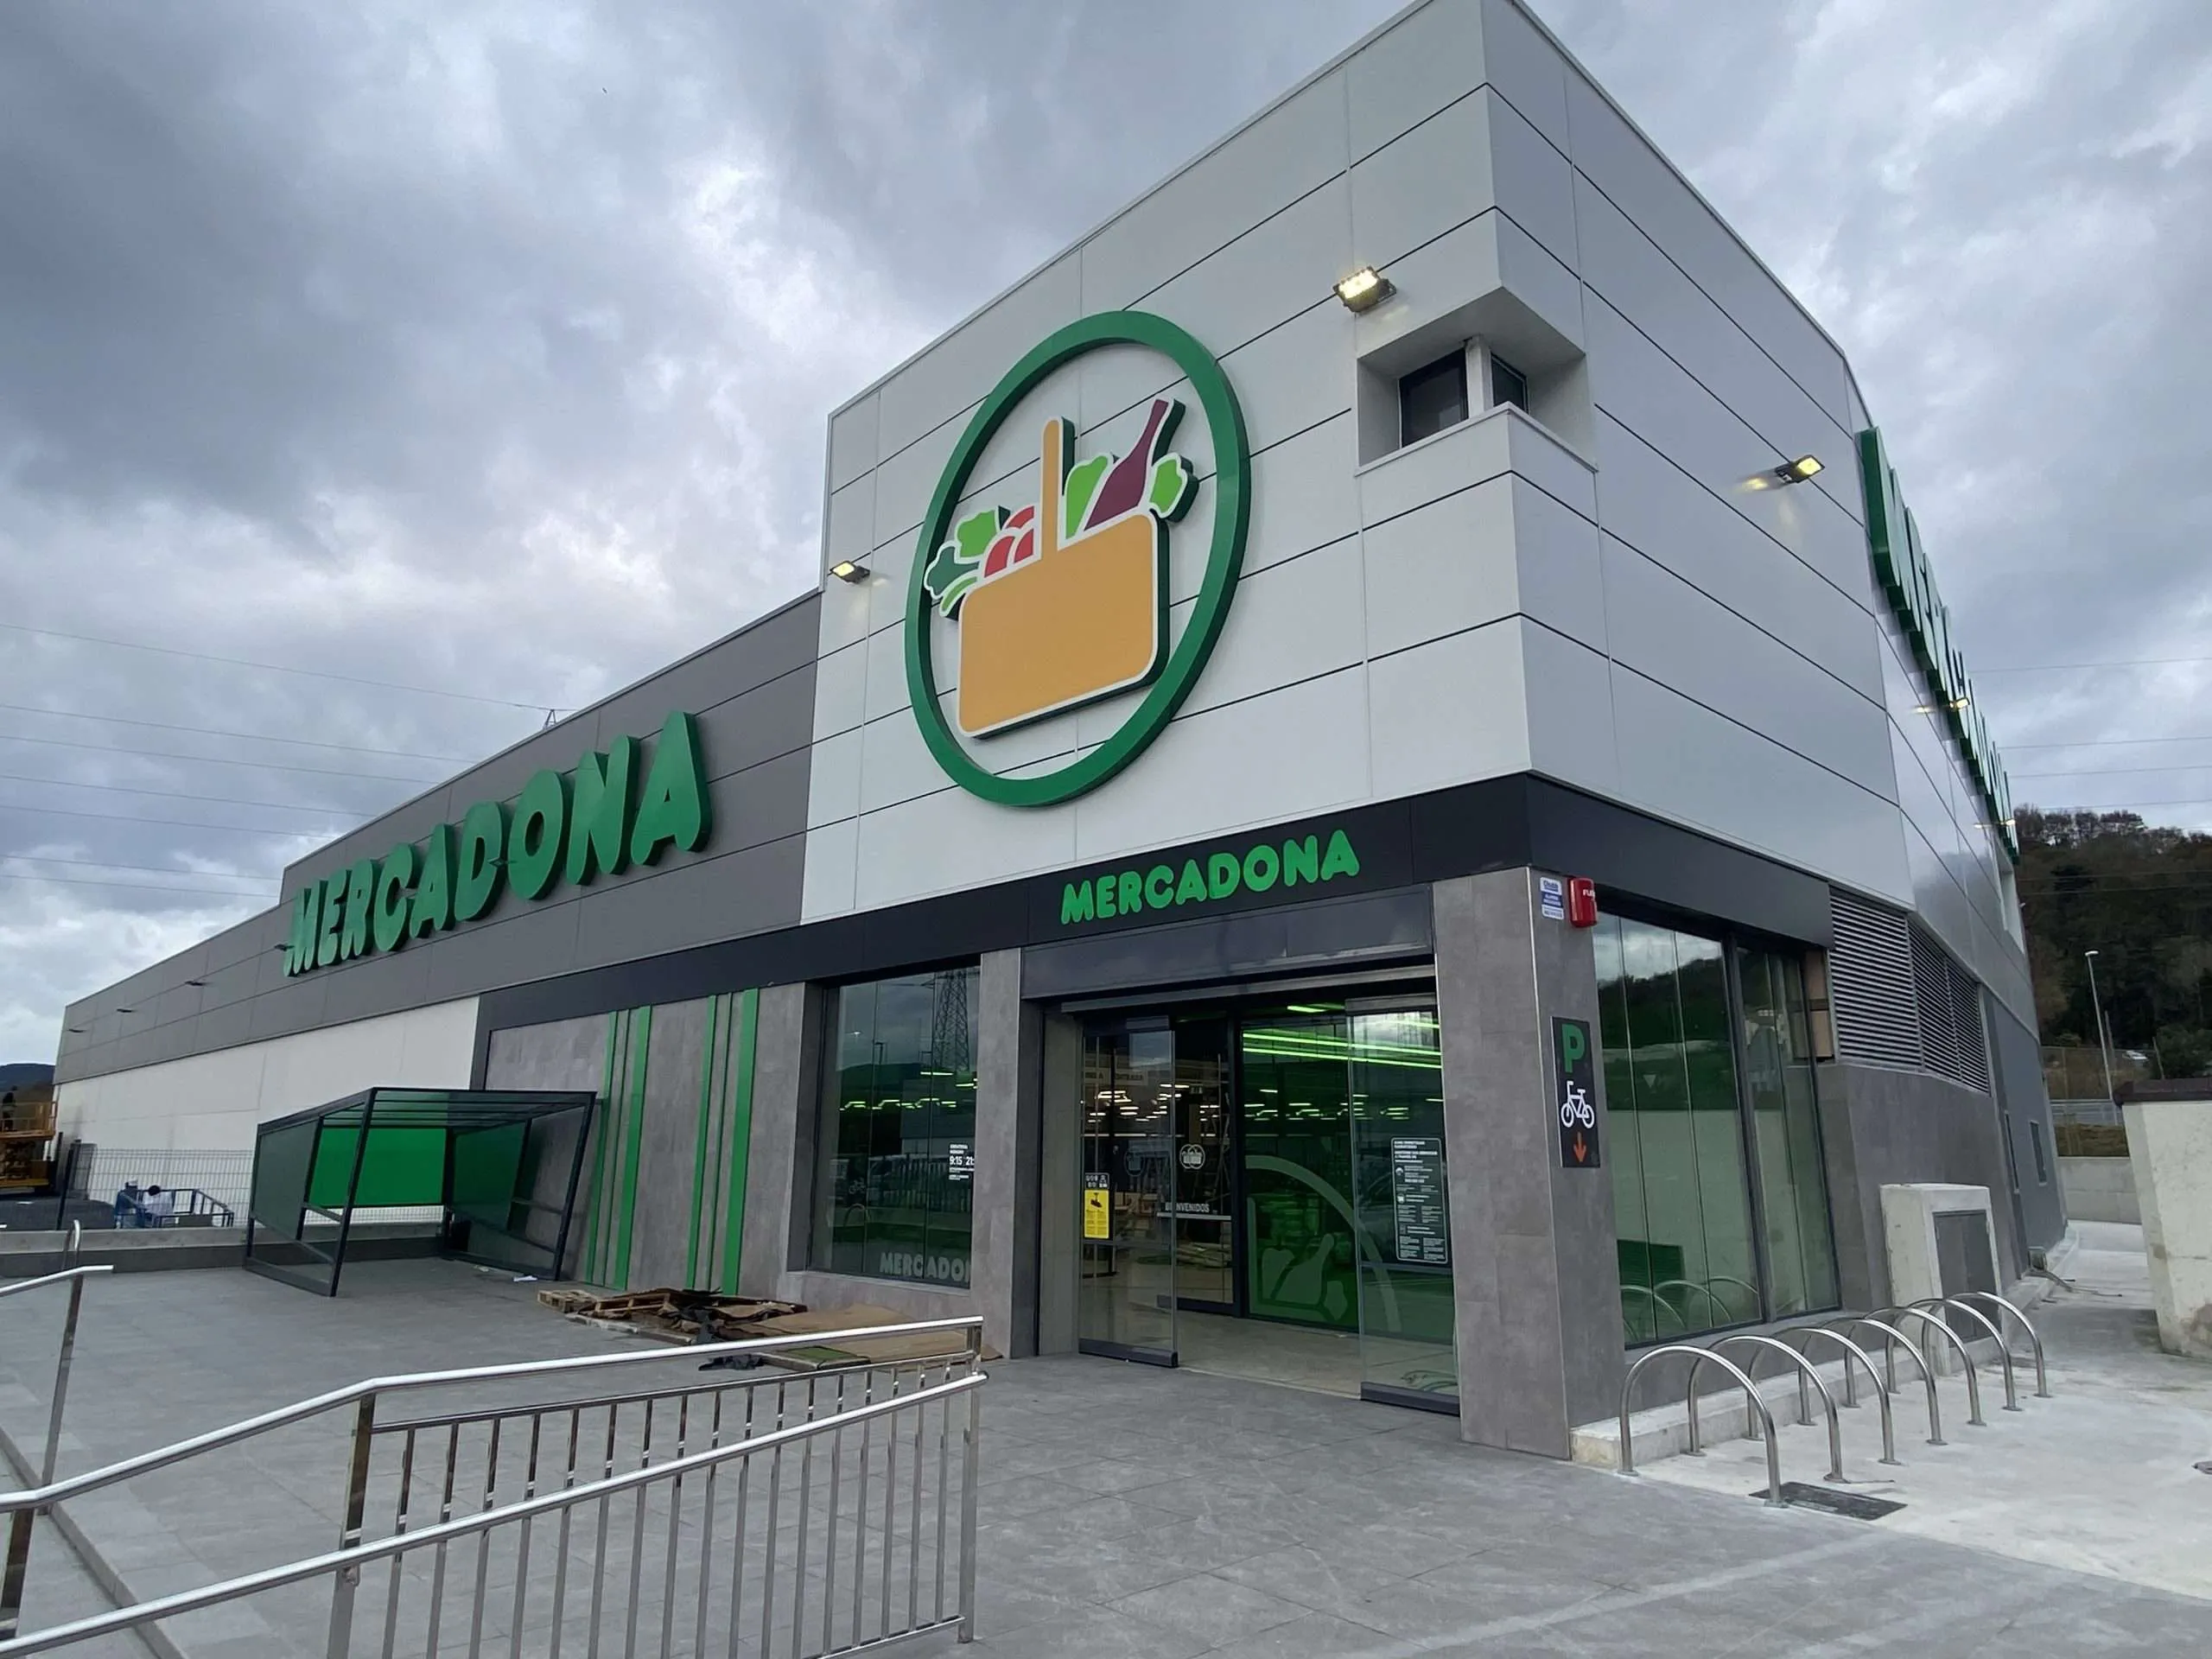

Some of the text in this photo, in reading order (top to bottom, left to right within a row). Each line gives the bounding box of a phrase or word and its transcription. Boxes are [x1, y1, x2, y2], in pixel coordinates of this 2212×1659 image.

[283, 710, 711, 976] MERCADONA
[1061, 830, 1360, 924] MERCADONA
[1561, 1023, 1585, 1072] P
